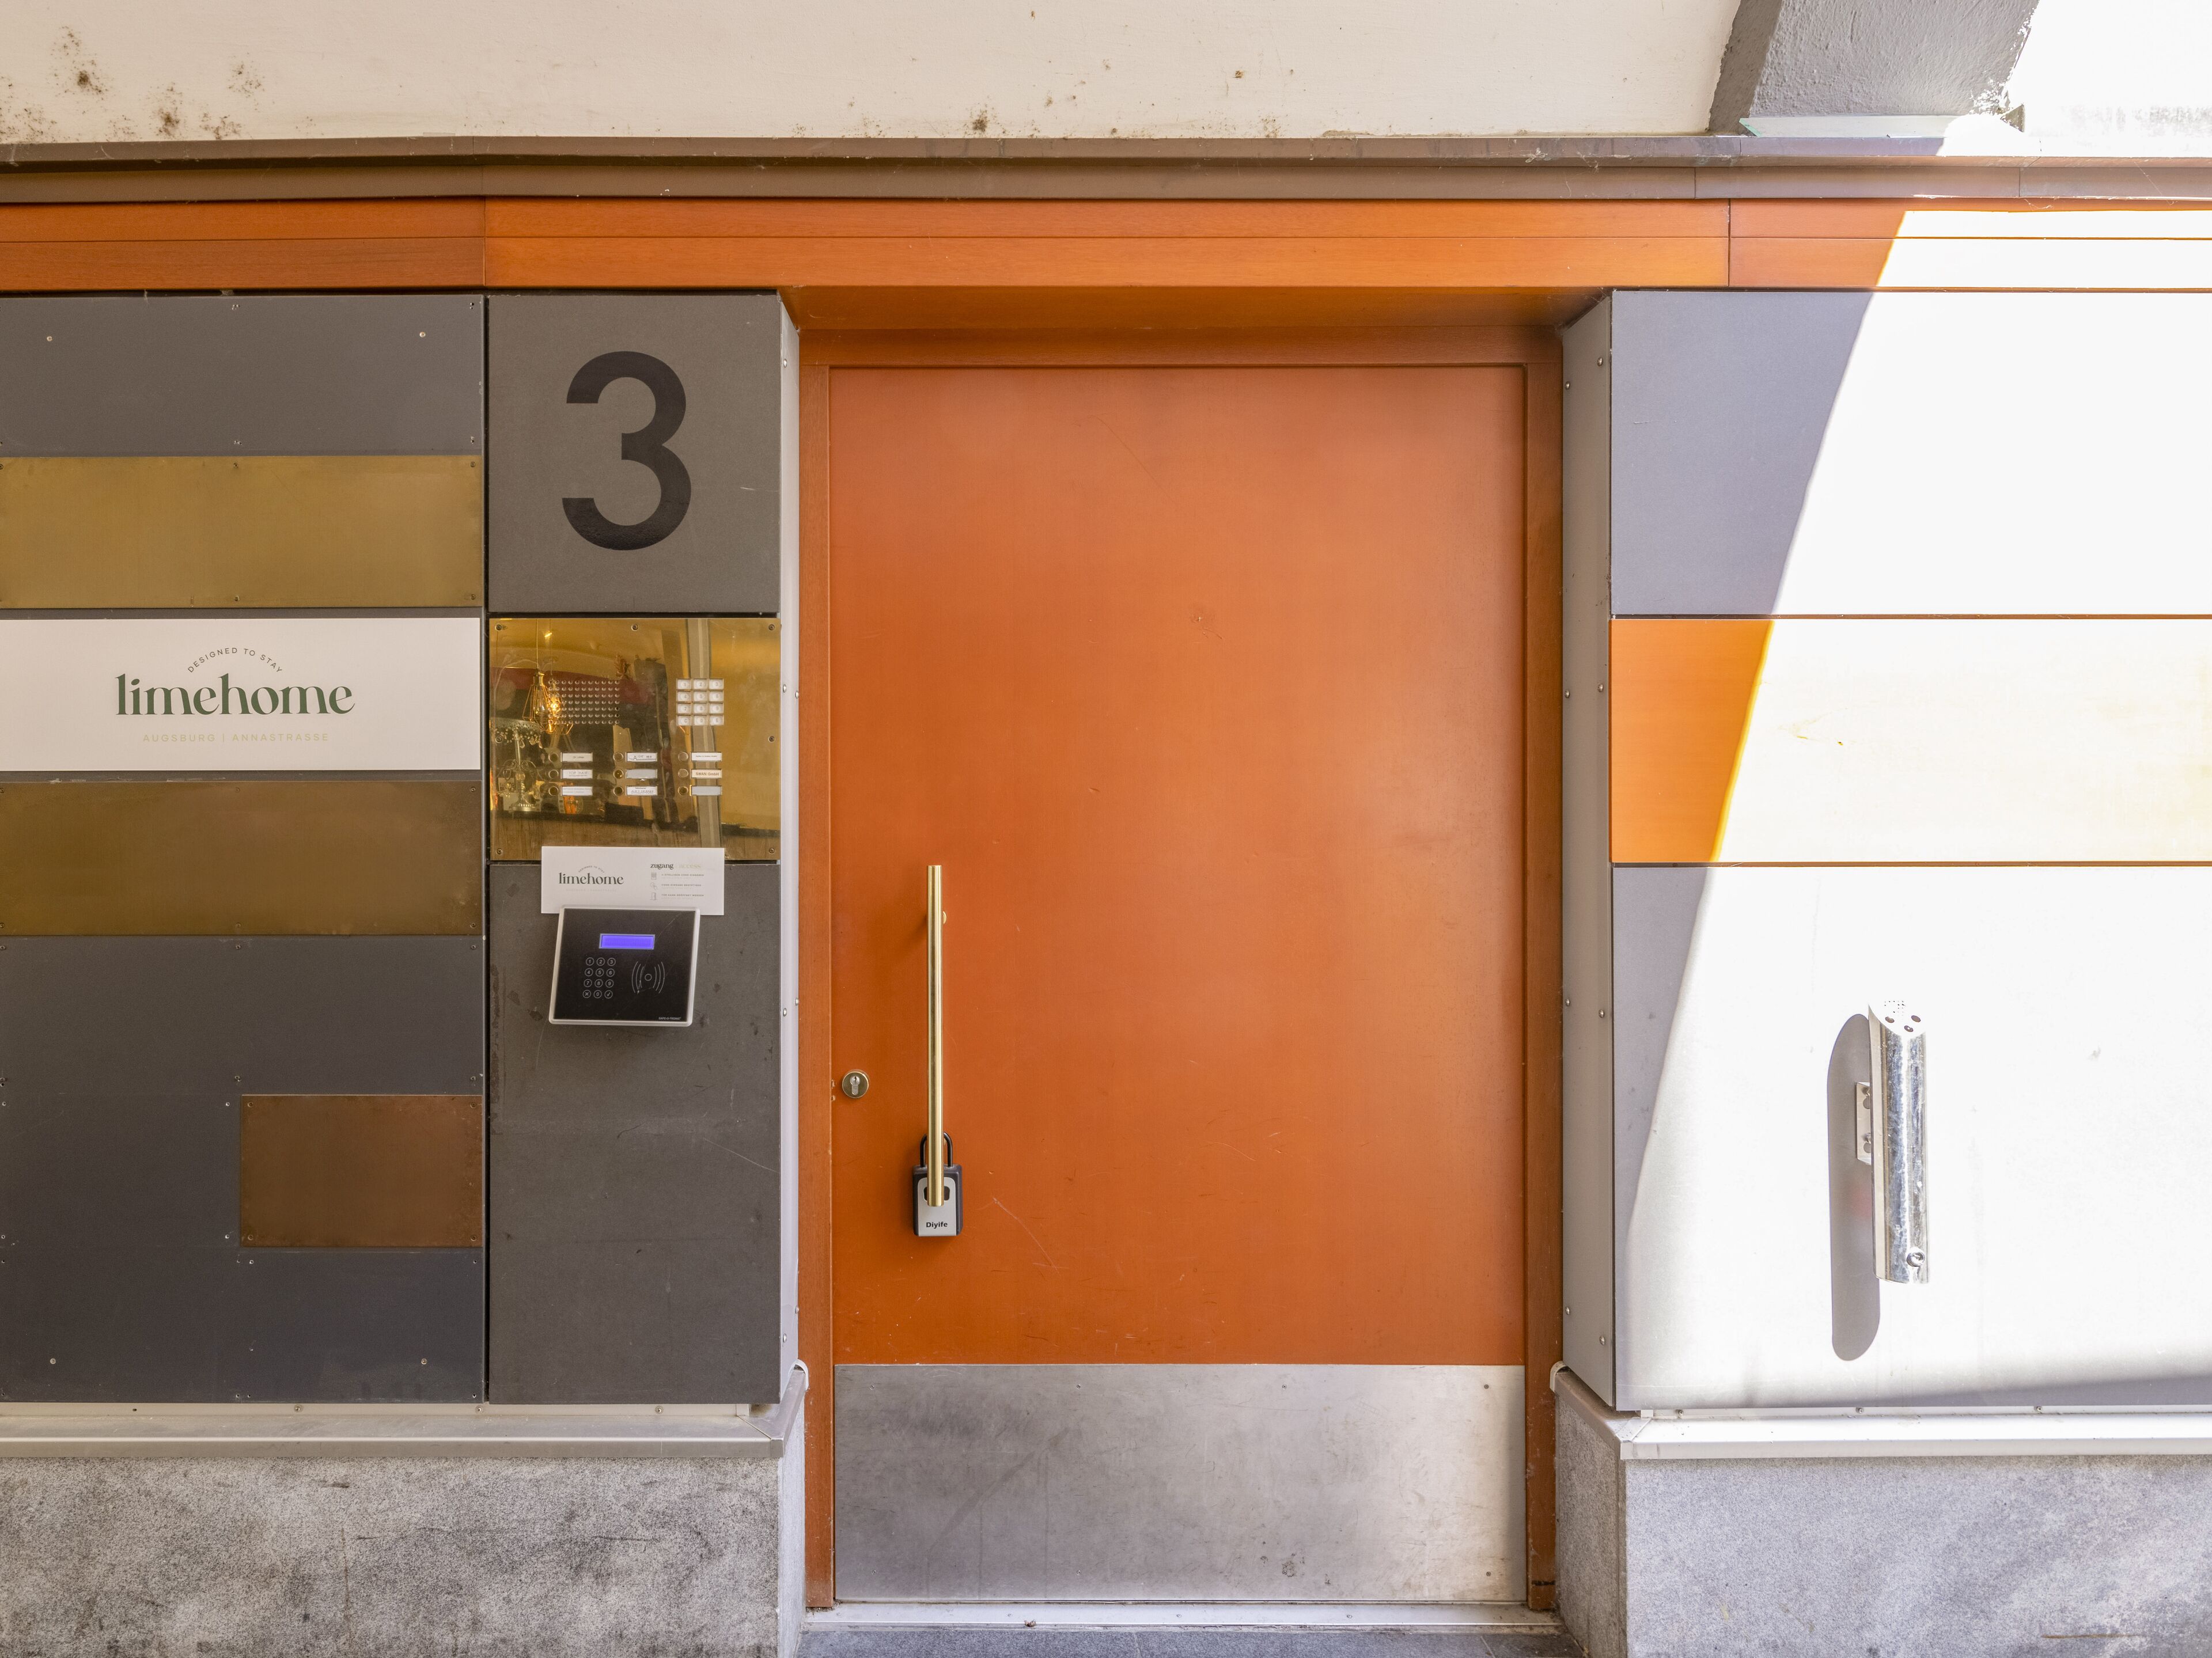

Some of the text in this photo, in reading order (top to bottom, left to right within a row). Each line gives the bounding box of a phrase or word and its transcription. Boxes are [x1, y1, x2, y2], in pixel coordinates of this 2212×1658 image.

[562, 351, 691, 551] 3
[188, 647, 283, 673] DESIGNED TO STAY
[115, 673, 355, 715] limehome
[232, 733, 328, 742] ANNASTRASSE
[559, 872, 624, 885] limehome
